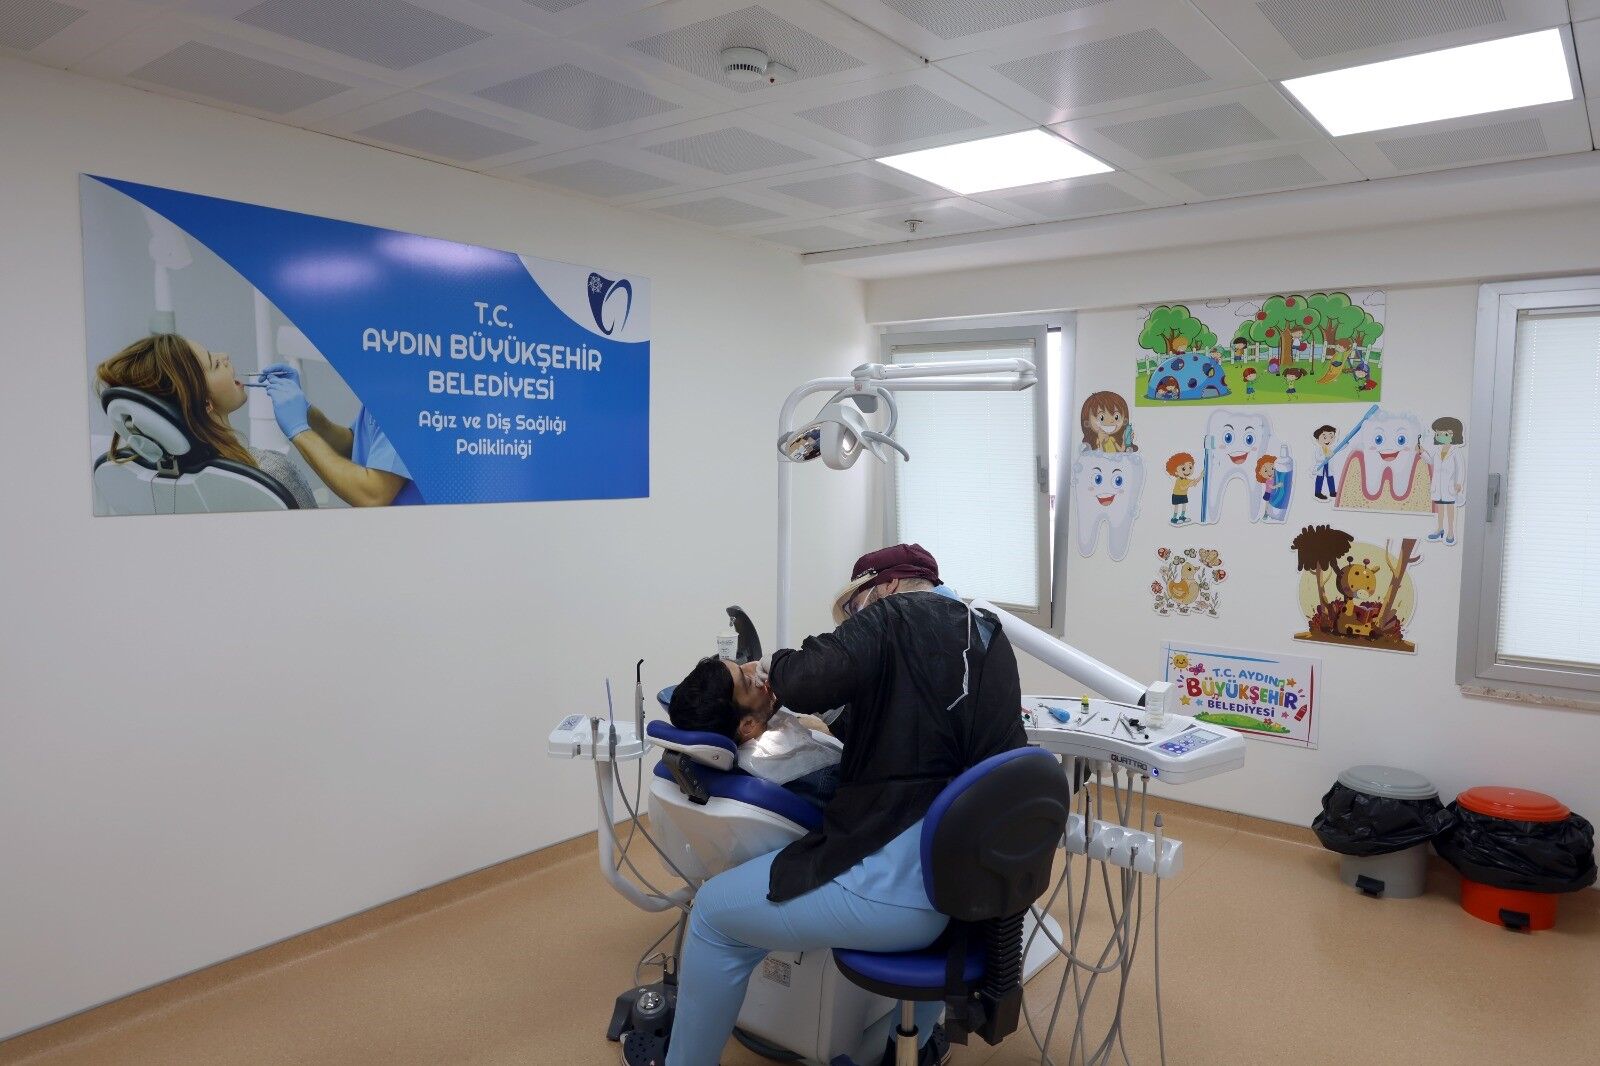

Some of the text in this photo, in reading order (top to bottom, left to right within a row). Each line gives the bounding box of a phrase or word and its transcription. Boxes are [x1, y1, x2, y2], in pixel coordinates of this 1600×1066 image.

[474, 302, 513, 328] T.C.
[362, 327, 602, 373] AYDIN BÜYÜKŞEHİR
[428, 370, 555, 400] BELEDİYESİ
[418, 410, 566, 435] Ağız ve Diş Sağlığı
[456, 439, 532, 459] Polikliniği
[1212, 668, 1279, 686] T.C. AYDIN
[1186, 676, 1298, 710] BÜYÜKŞEHİR
[1207, 699, 1275, 718] BELEDİYESİ
[1111, 754, 1148, 770] QUATTRO
